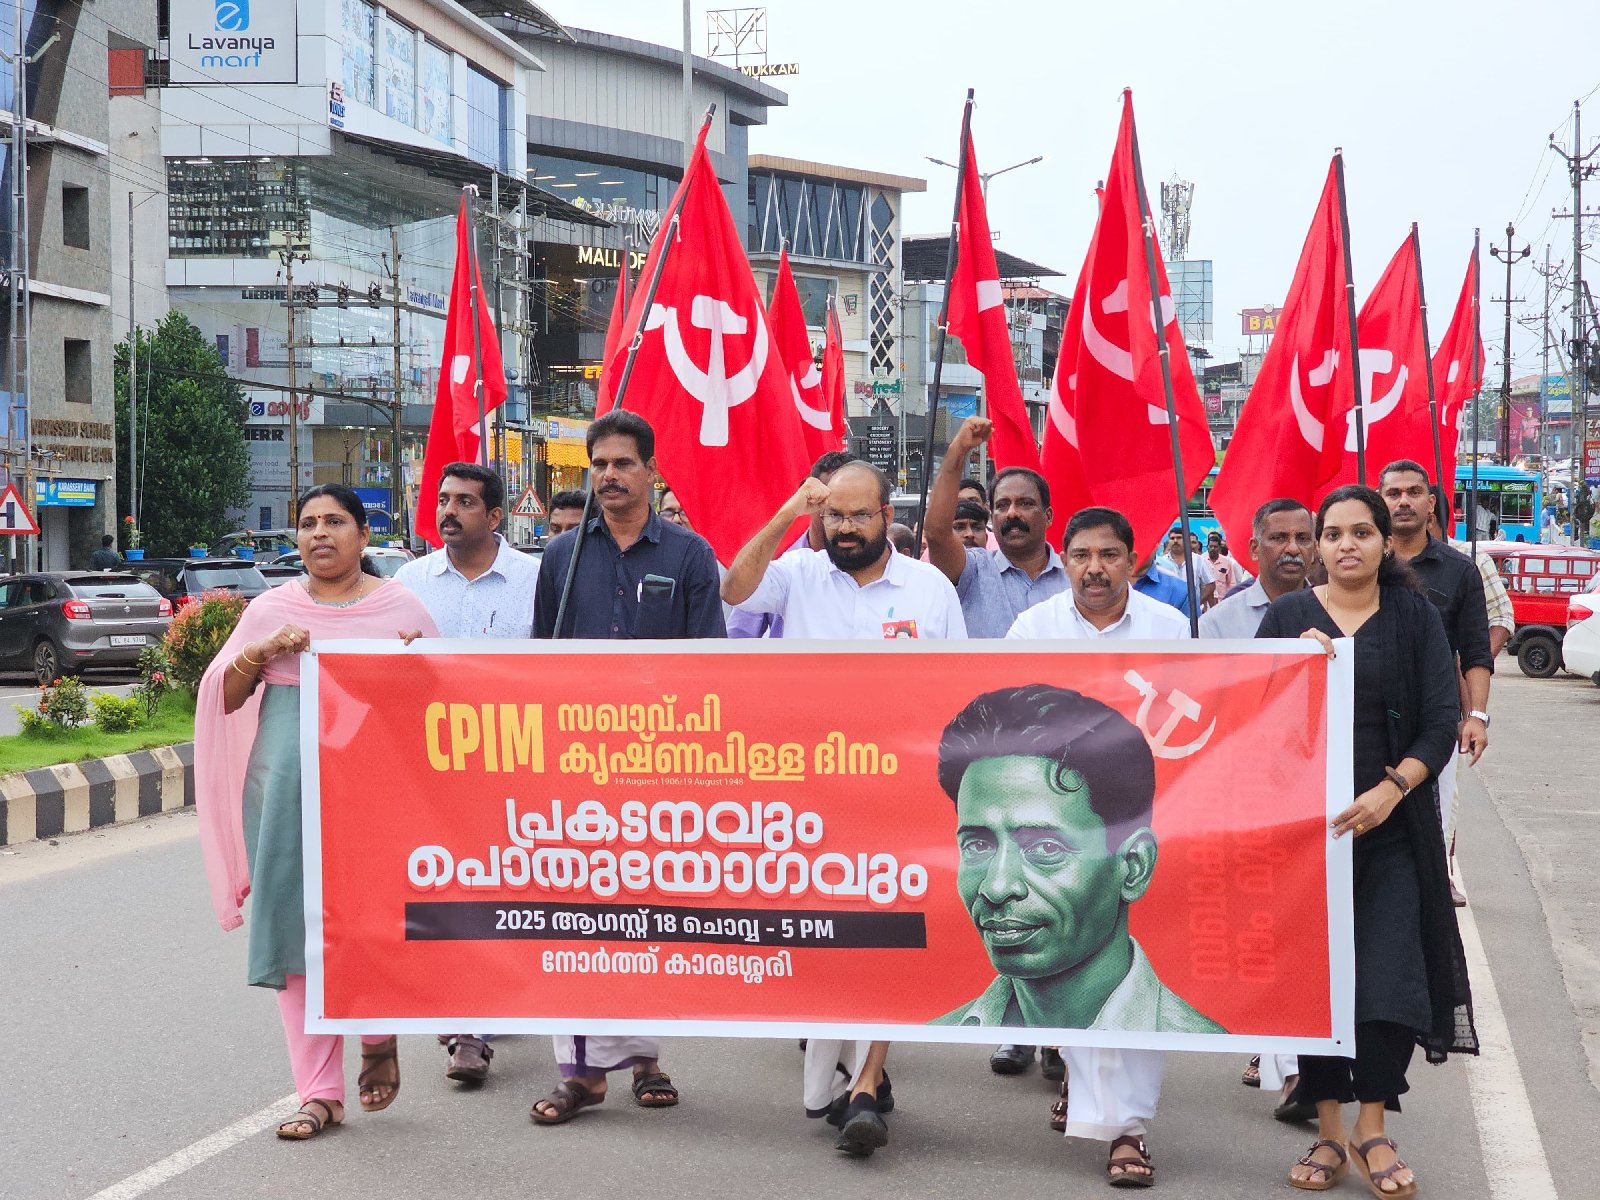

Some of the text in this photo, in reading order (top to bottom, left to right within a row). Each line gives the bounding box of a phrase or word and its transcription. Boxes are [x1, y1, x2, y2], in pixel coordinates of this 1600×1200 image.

[188, 33, 275, 54] Lavanya
[201, 52, 261, 68] mart
[741, 63, 799, 77] MUKKAM
[578, 246, 621, 268] MALL
[1249, 315, 1281, 331] BA
[424, 701, 546, 773] CPIM
[559, 730, 898, 785] കൃഷ്ണപിള്ള ദിനം
[694, 778, 723, 787] August
[725, 778, 745, 786] 1948
[505, 798, 824, 851] പ്രകടനവും
[407, 844, 929, 905] പൊതുയോഗവും
[495, 909, 546, 931] 2025
[552, 909, 650, 939] ആഗസ്റ്റ്
[653, 912, 678, 934] 18
[683, 915, 761, 943] ചൊവ്വ
[782, 918, 795, 939] 5
[800, 918, 835, 940] PM
[541, 946, 794, 985] നോർത്ത് കാരശ്ശേരി
